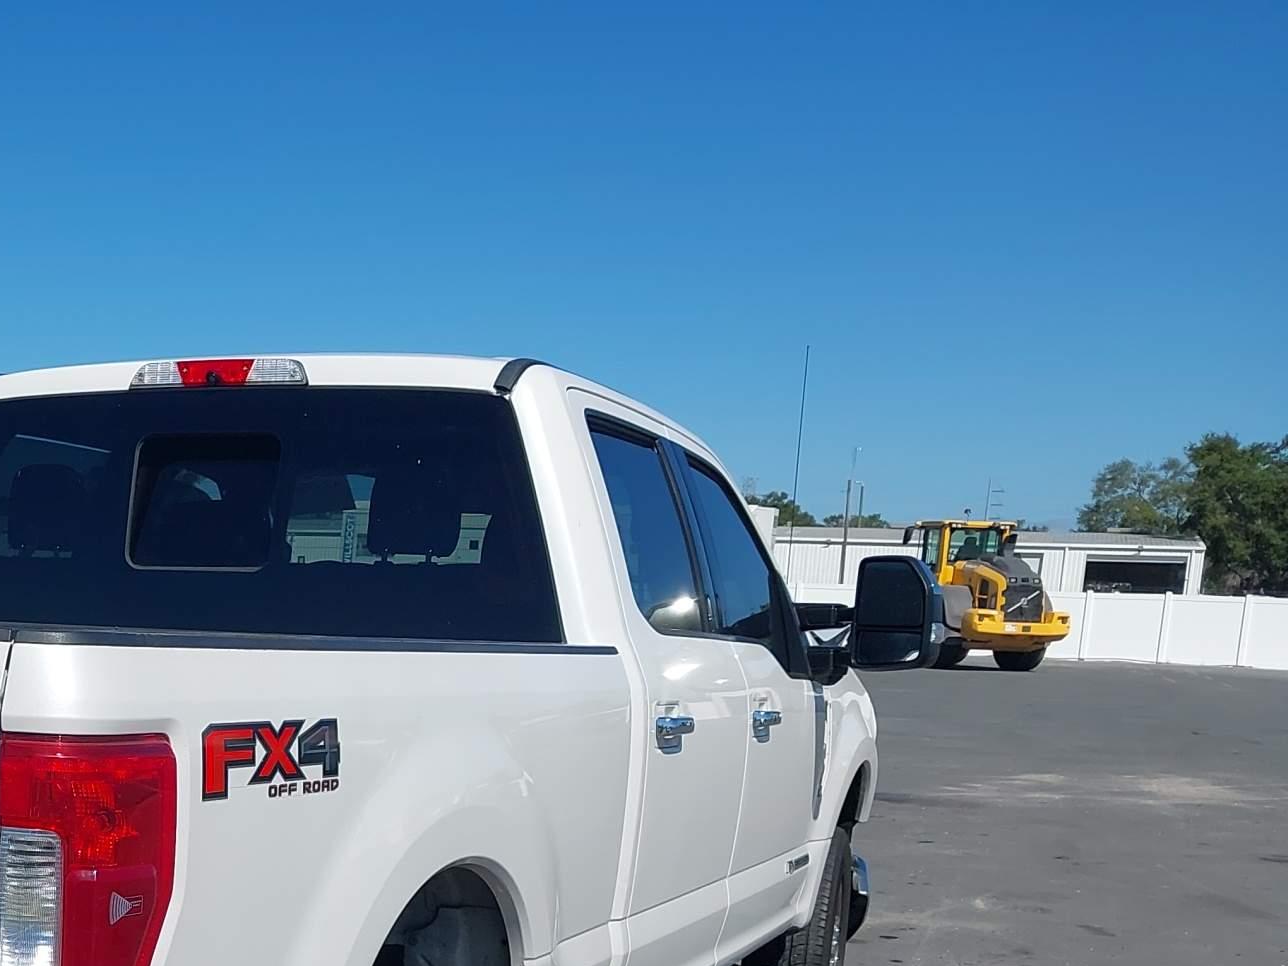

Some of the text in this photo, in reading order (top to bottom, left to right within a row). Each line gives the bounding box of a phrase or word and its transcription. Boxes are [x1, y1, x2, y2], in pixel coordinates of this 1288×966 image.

[202, 718, 340, 802] FX4
[268, 779, 340, 798] OFF ROAD
